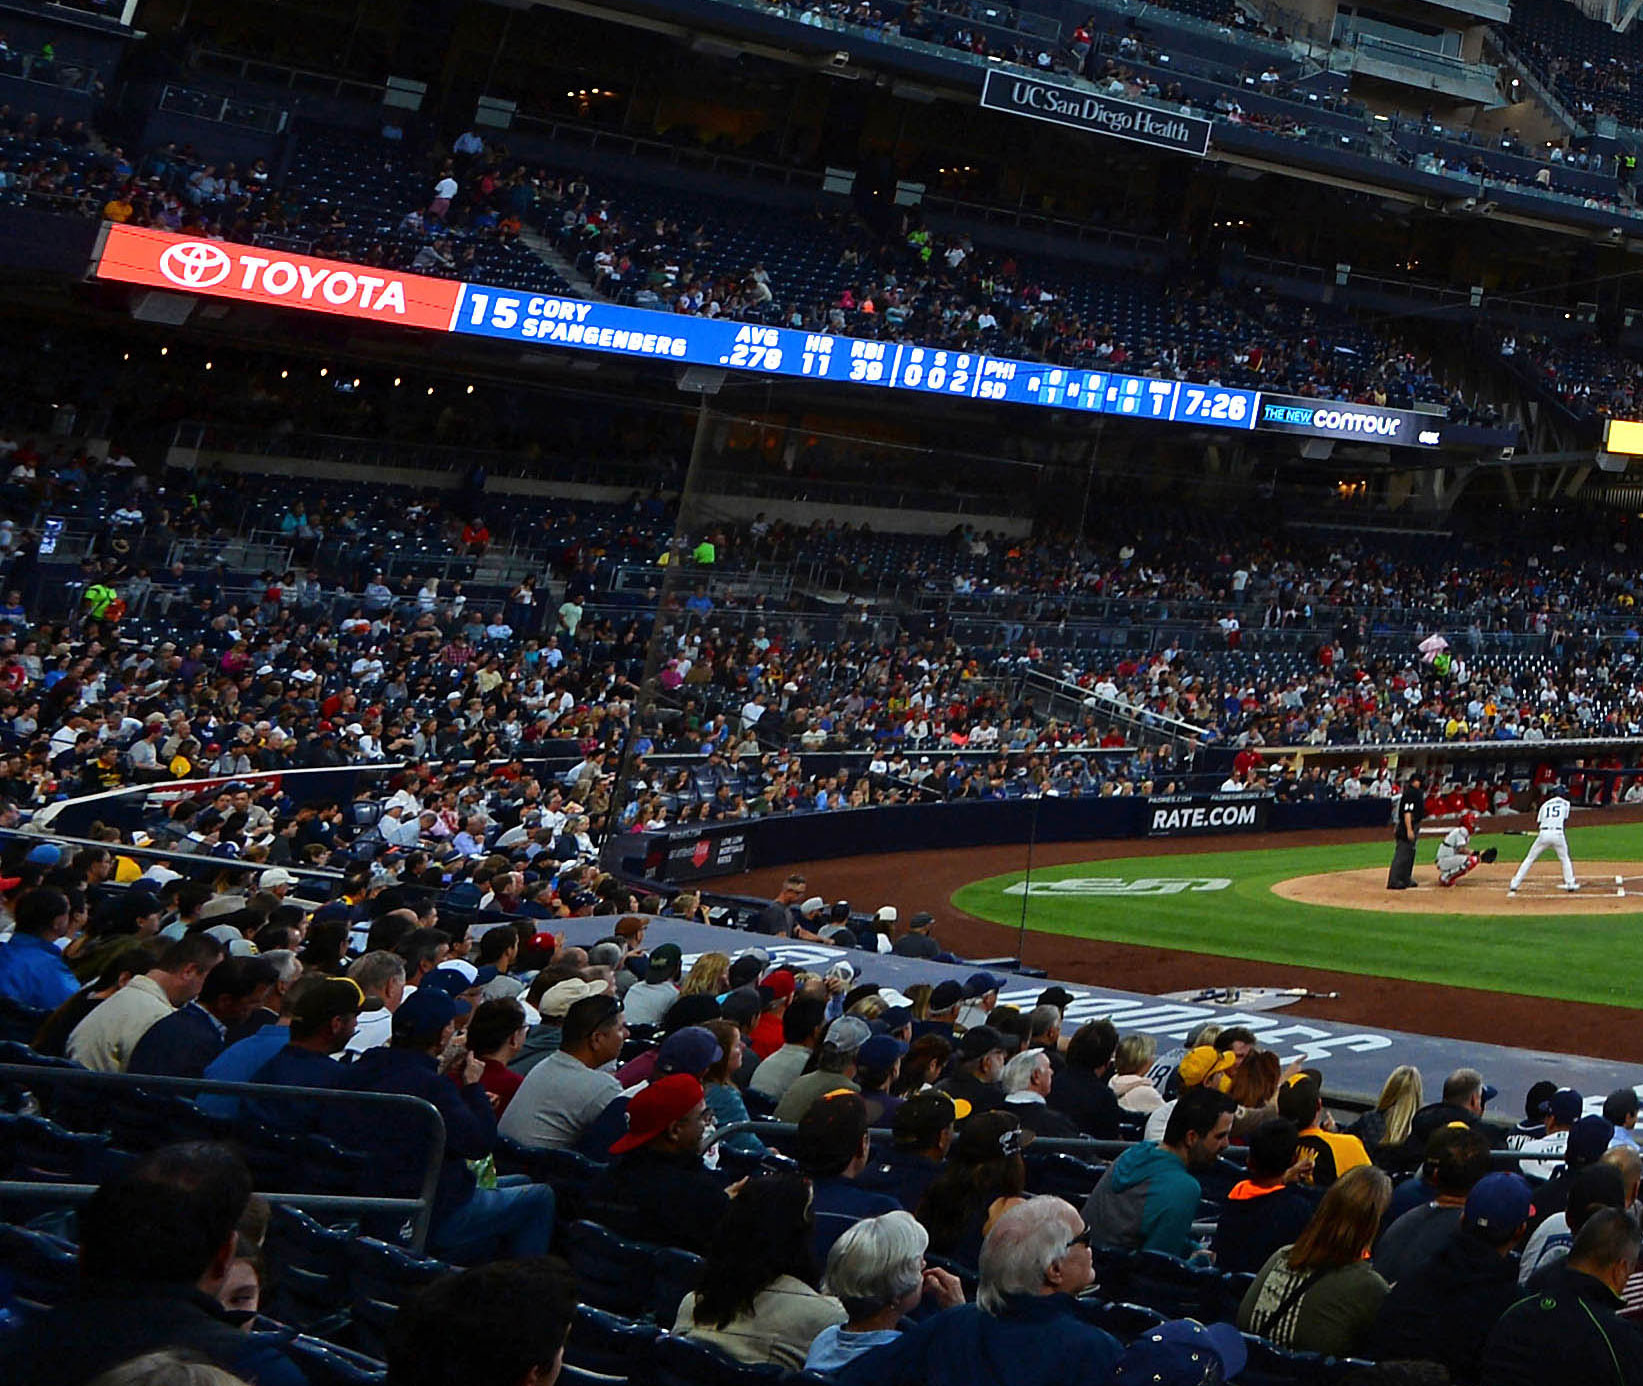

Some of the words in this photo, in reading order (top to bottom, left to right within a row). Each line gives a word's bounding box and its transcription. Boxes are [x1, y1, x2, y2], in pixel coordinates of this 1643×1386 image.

[1012, 82, 1043, 109] UC
[1044, 91, 1080, 117] San
[1082, 99, 1133, 131] Diego
[1133, 112, 1189, 142] Health
[239, 255, 408, 314] TOYOTA
[469, 293, 520, 331] 15
[527, 297, 592, 323] CORY
[521, 320, 687, 358] SPANGENBERG
[735, 325, 780, 346] AVG
[804, 334, 833, 355] HR
[719, 343, 783, 370] .278
[801, 352, 831, 377] 11
[984, 360, 1017, 381] PHI
[979, 380, 1007, 400] SD
[1185, 390, 1247, 421] 7:26
[1265, 404, 1285, 422] THE
[1286, 407, 1313, 426] NEW
[1151, 805, 1256, 830] RATE.COM
[1545, 805, 1562, 819] 15
